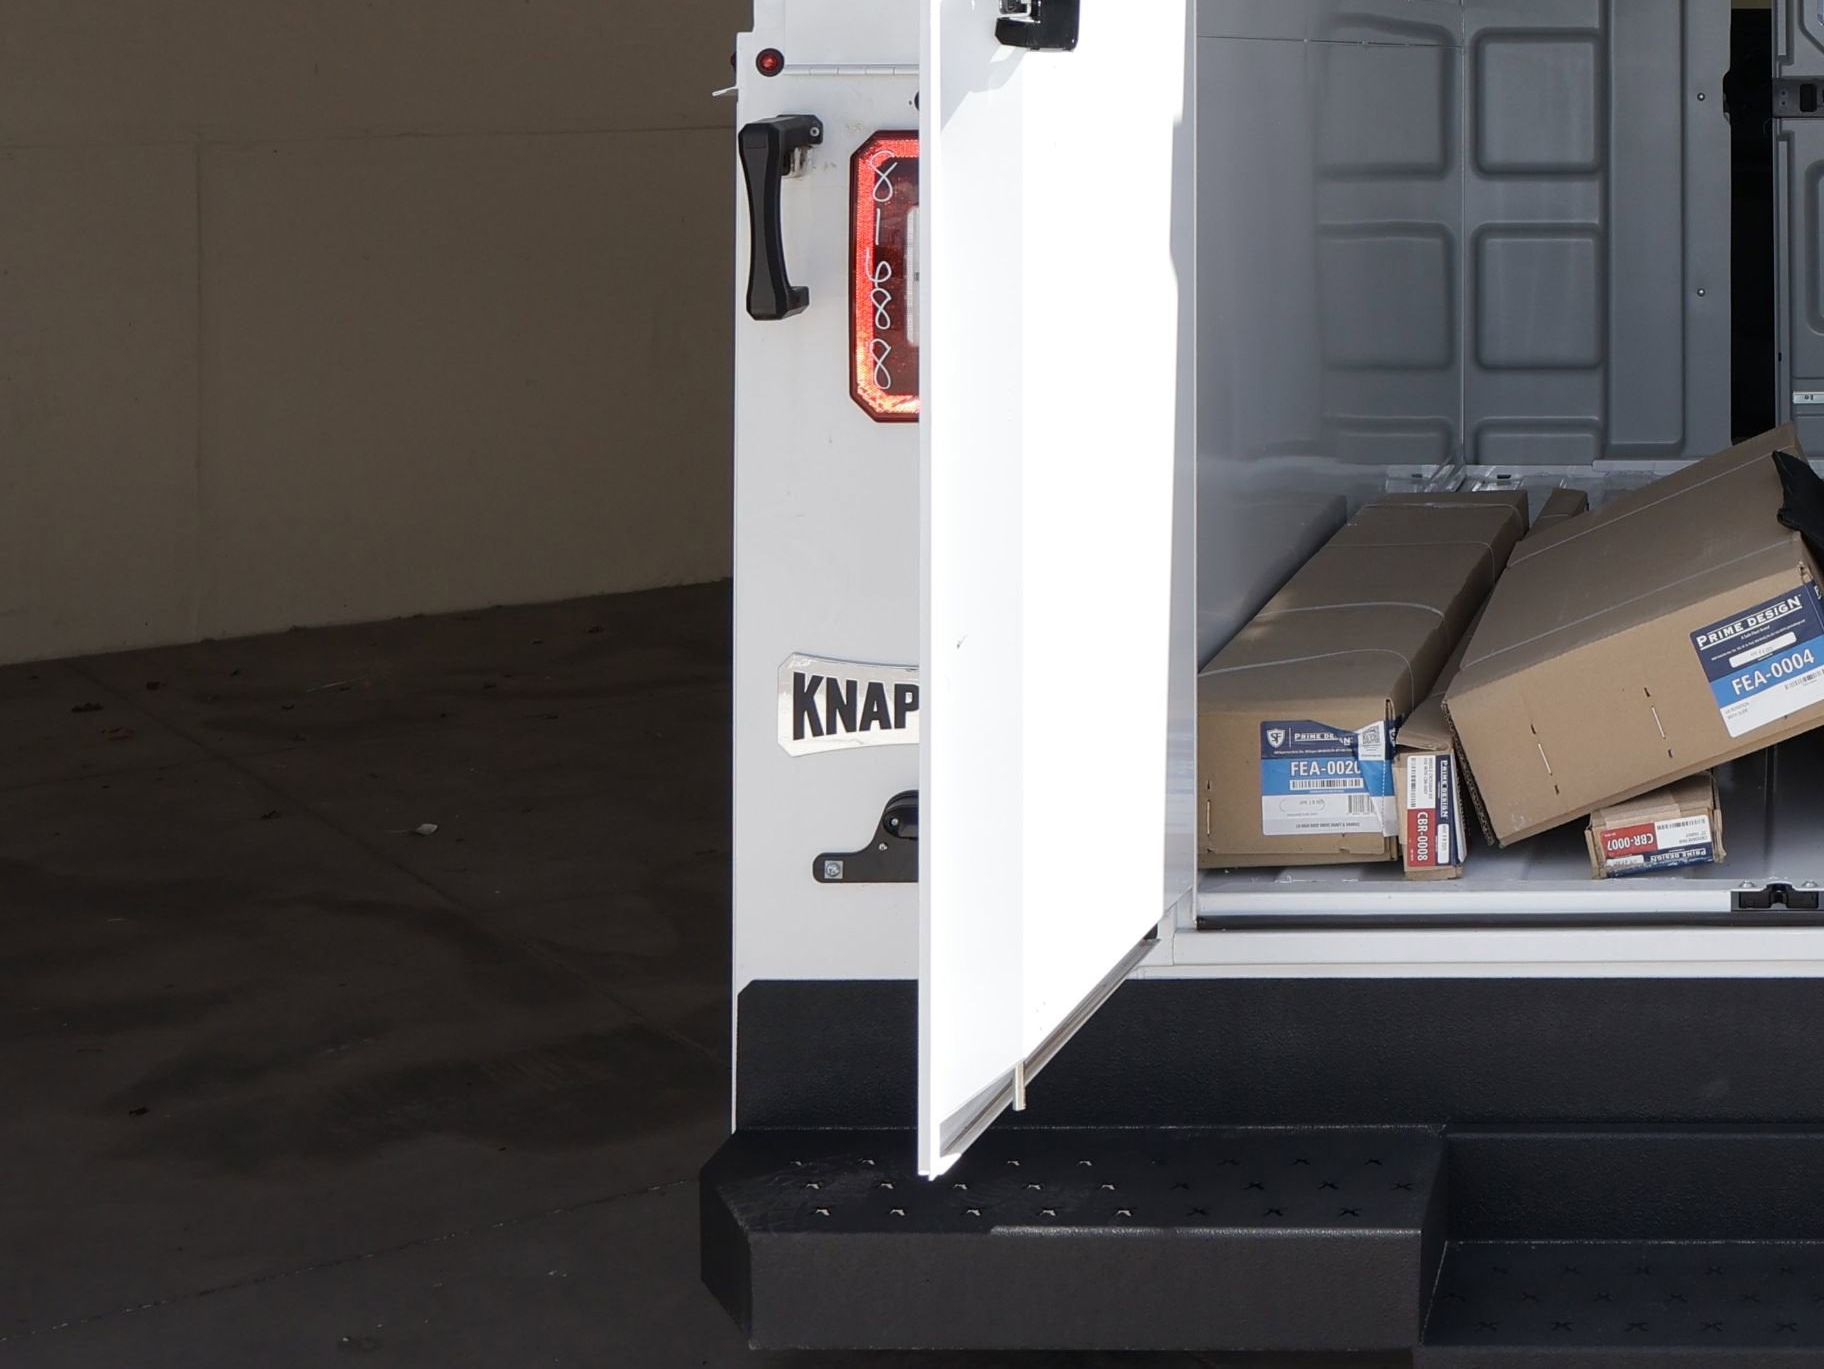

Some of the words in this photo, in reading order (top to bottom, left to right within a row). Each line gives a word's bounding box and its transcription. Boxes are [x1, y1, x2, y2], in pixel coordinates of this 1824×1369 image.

[1696, 622, 1744, 647] PRIME
[1747, 596, 1802, 627] DESIGN
[1732, 648, 1815, 695] FEA-0004
[793, 672, 920, 741] KNAP
[1294, 732, 1321, 740] PRIME
[1440, 759, 1449, 785] PRIME
[1440, 787, 1449, 818] DESIGN
[1417, 811, 1429, 861] CBR-0008
[1607, 833, 1654, 851] CBR-0007
[1650, 851, 1681, 863] DESIGN
[1682, 847, 1707, 858] PRIME
